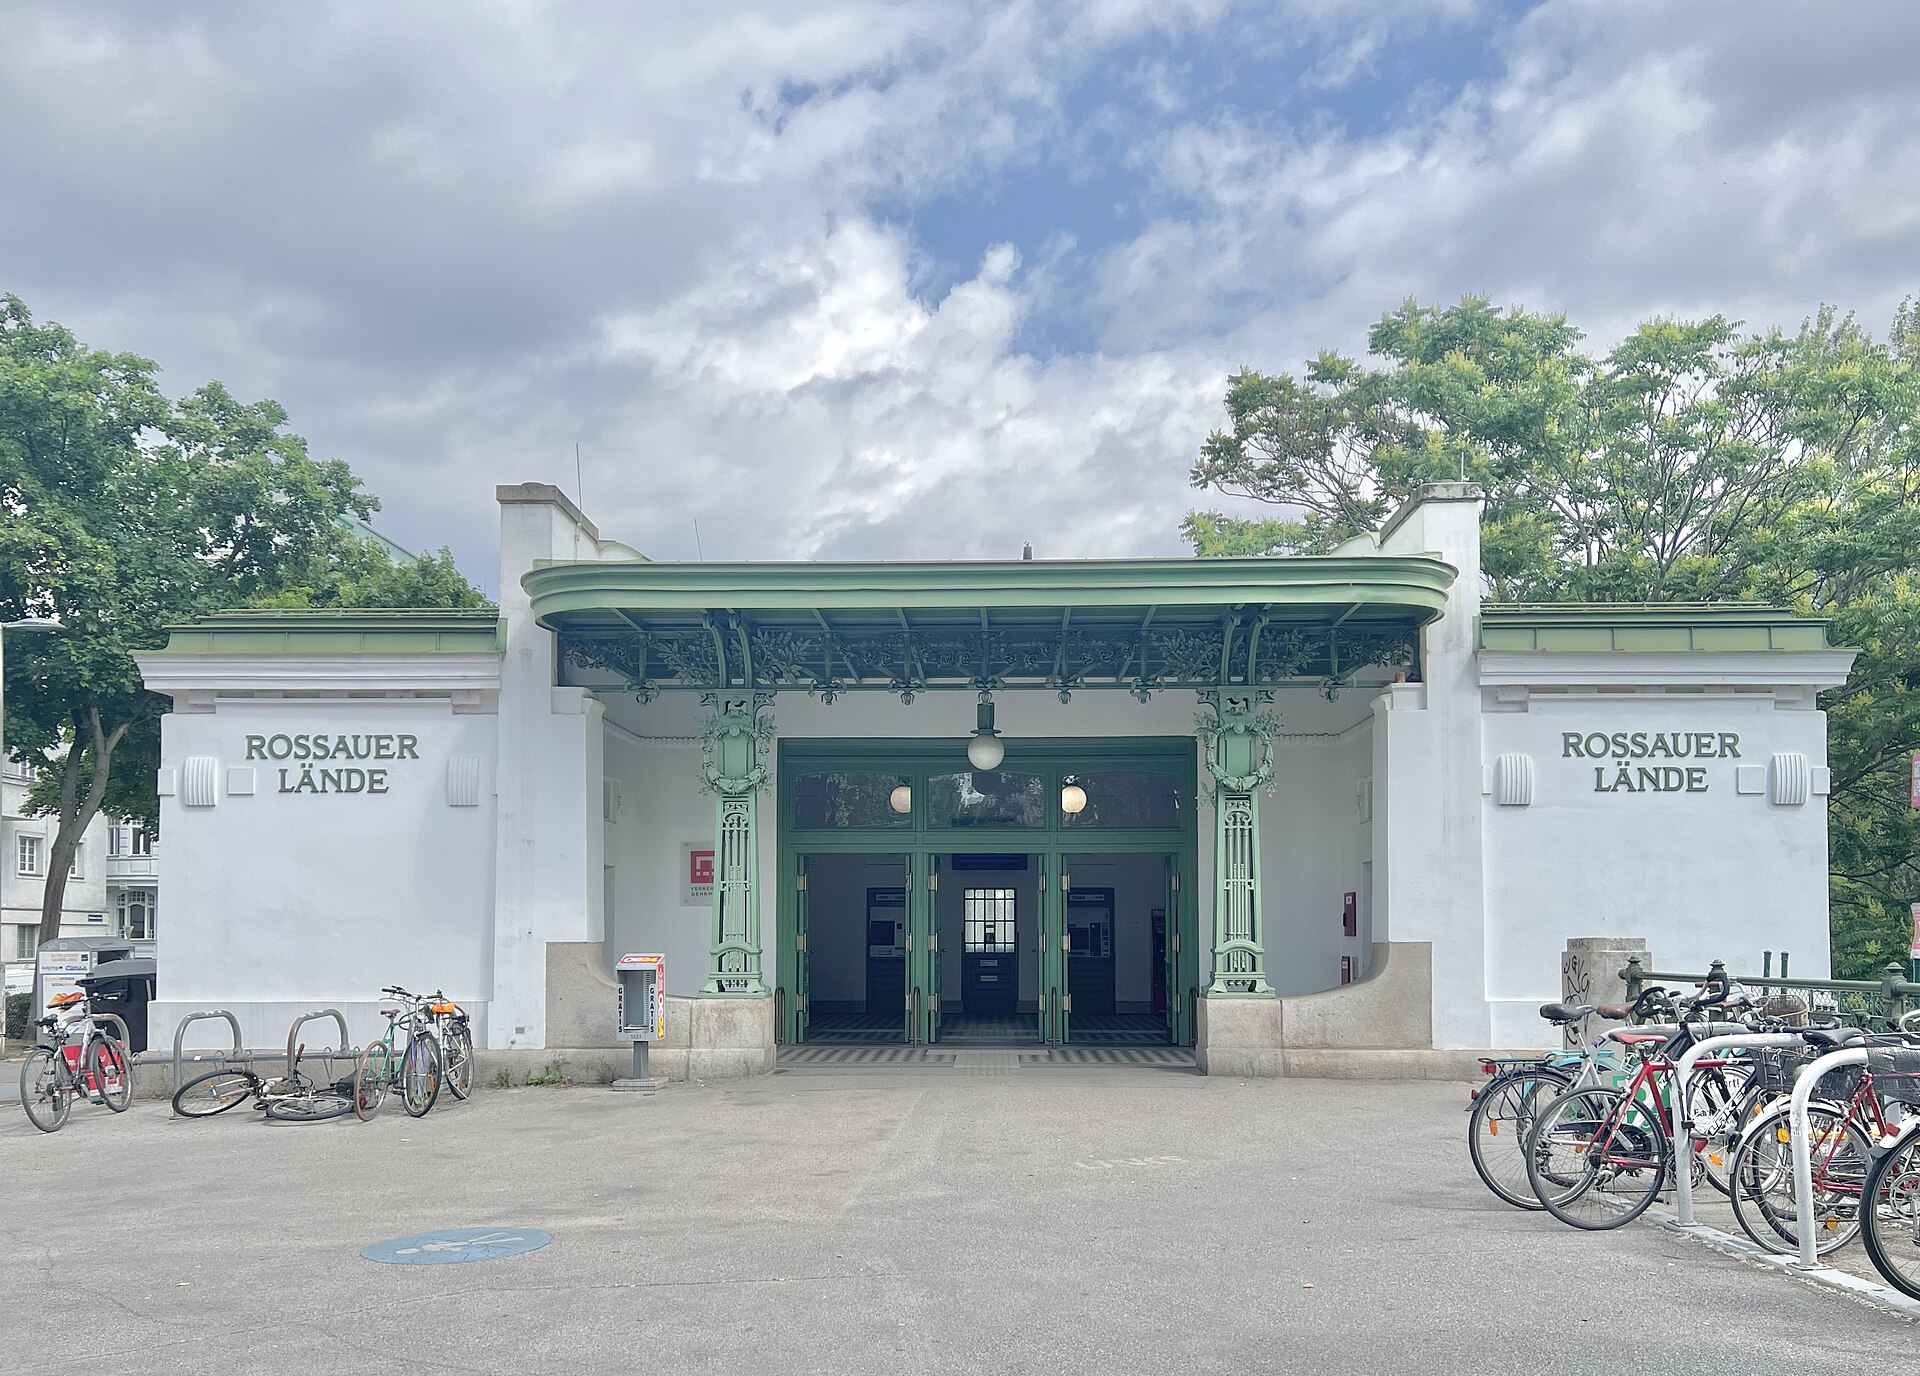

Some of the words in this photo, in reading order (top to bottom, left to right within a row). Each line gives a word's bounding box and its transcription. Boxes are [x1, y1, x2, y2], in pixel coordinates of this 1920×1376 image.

[245, 733, 419, 760] ROSSAUER
[1562, 732, 1741, 758] ROSSAUER
[278, 762, 390, 793] LÄNDE
[1594, 760, 1710, 792] LÄNDE
